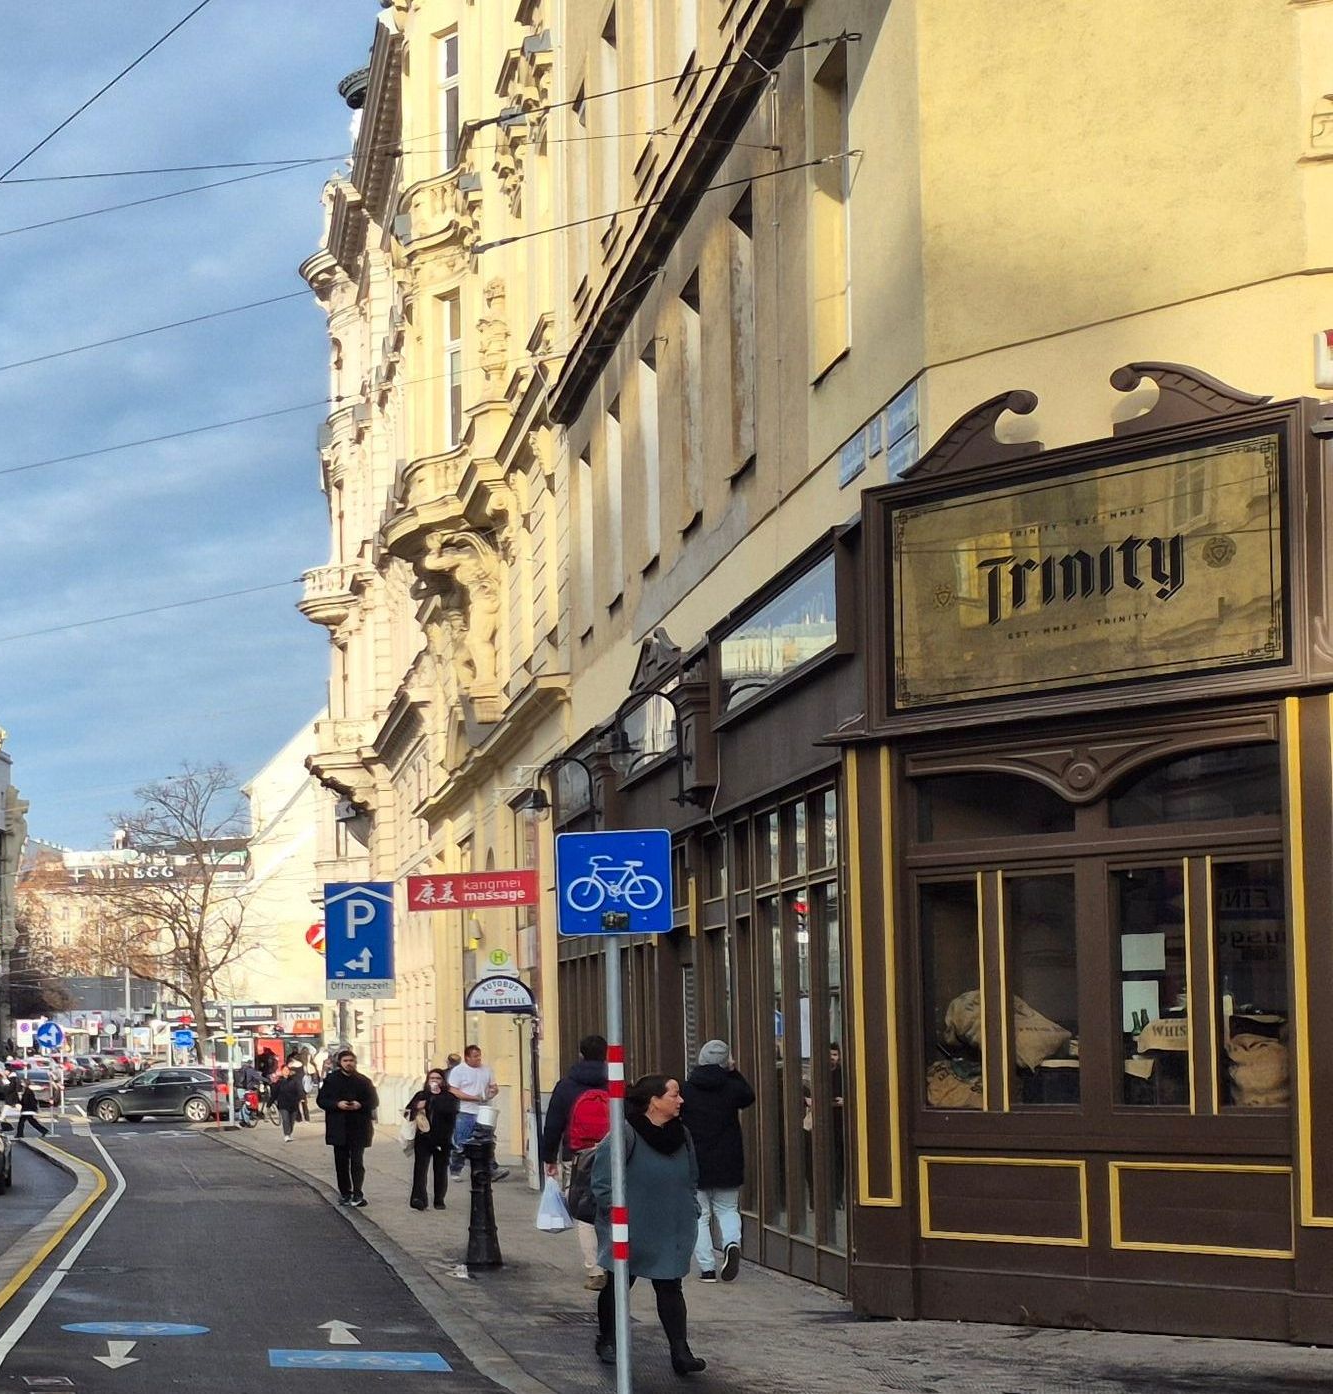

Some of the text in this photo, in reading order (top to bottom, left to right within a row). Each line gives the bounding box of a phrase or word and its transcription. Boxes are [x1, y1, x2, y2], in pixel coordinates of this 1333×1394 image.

[976, 532, 1188, 627] Trinity
[1007, 630, 1030, 639] EST
[1096, 611, 1149, 626] TRINITY
[462, 876, 521, 890] kangmei
[414, 880, 459, 904] 康美
[464, 888, 526, 902] massage
[347, 900, 376, 939] P
[481, 980, 520, 992] AUTOBUS
[475, 997, 526, 1005] HALTESTELLE
[1152, 1024, 1188, 1038] WHIS
